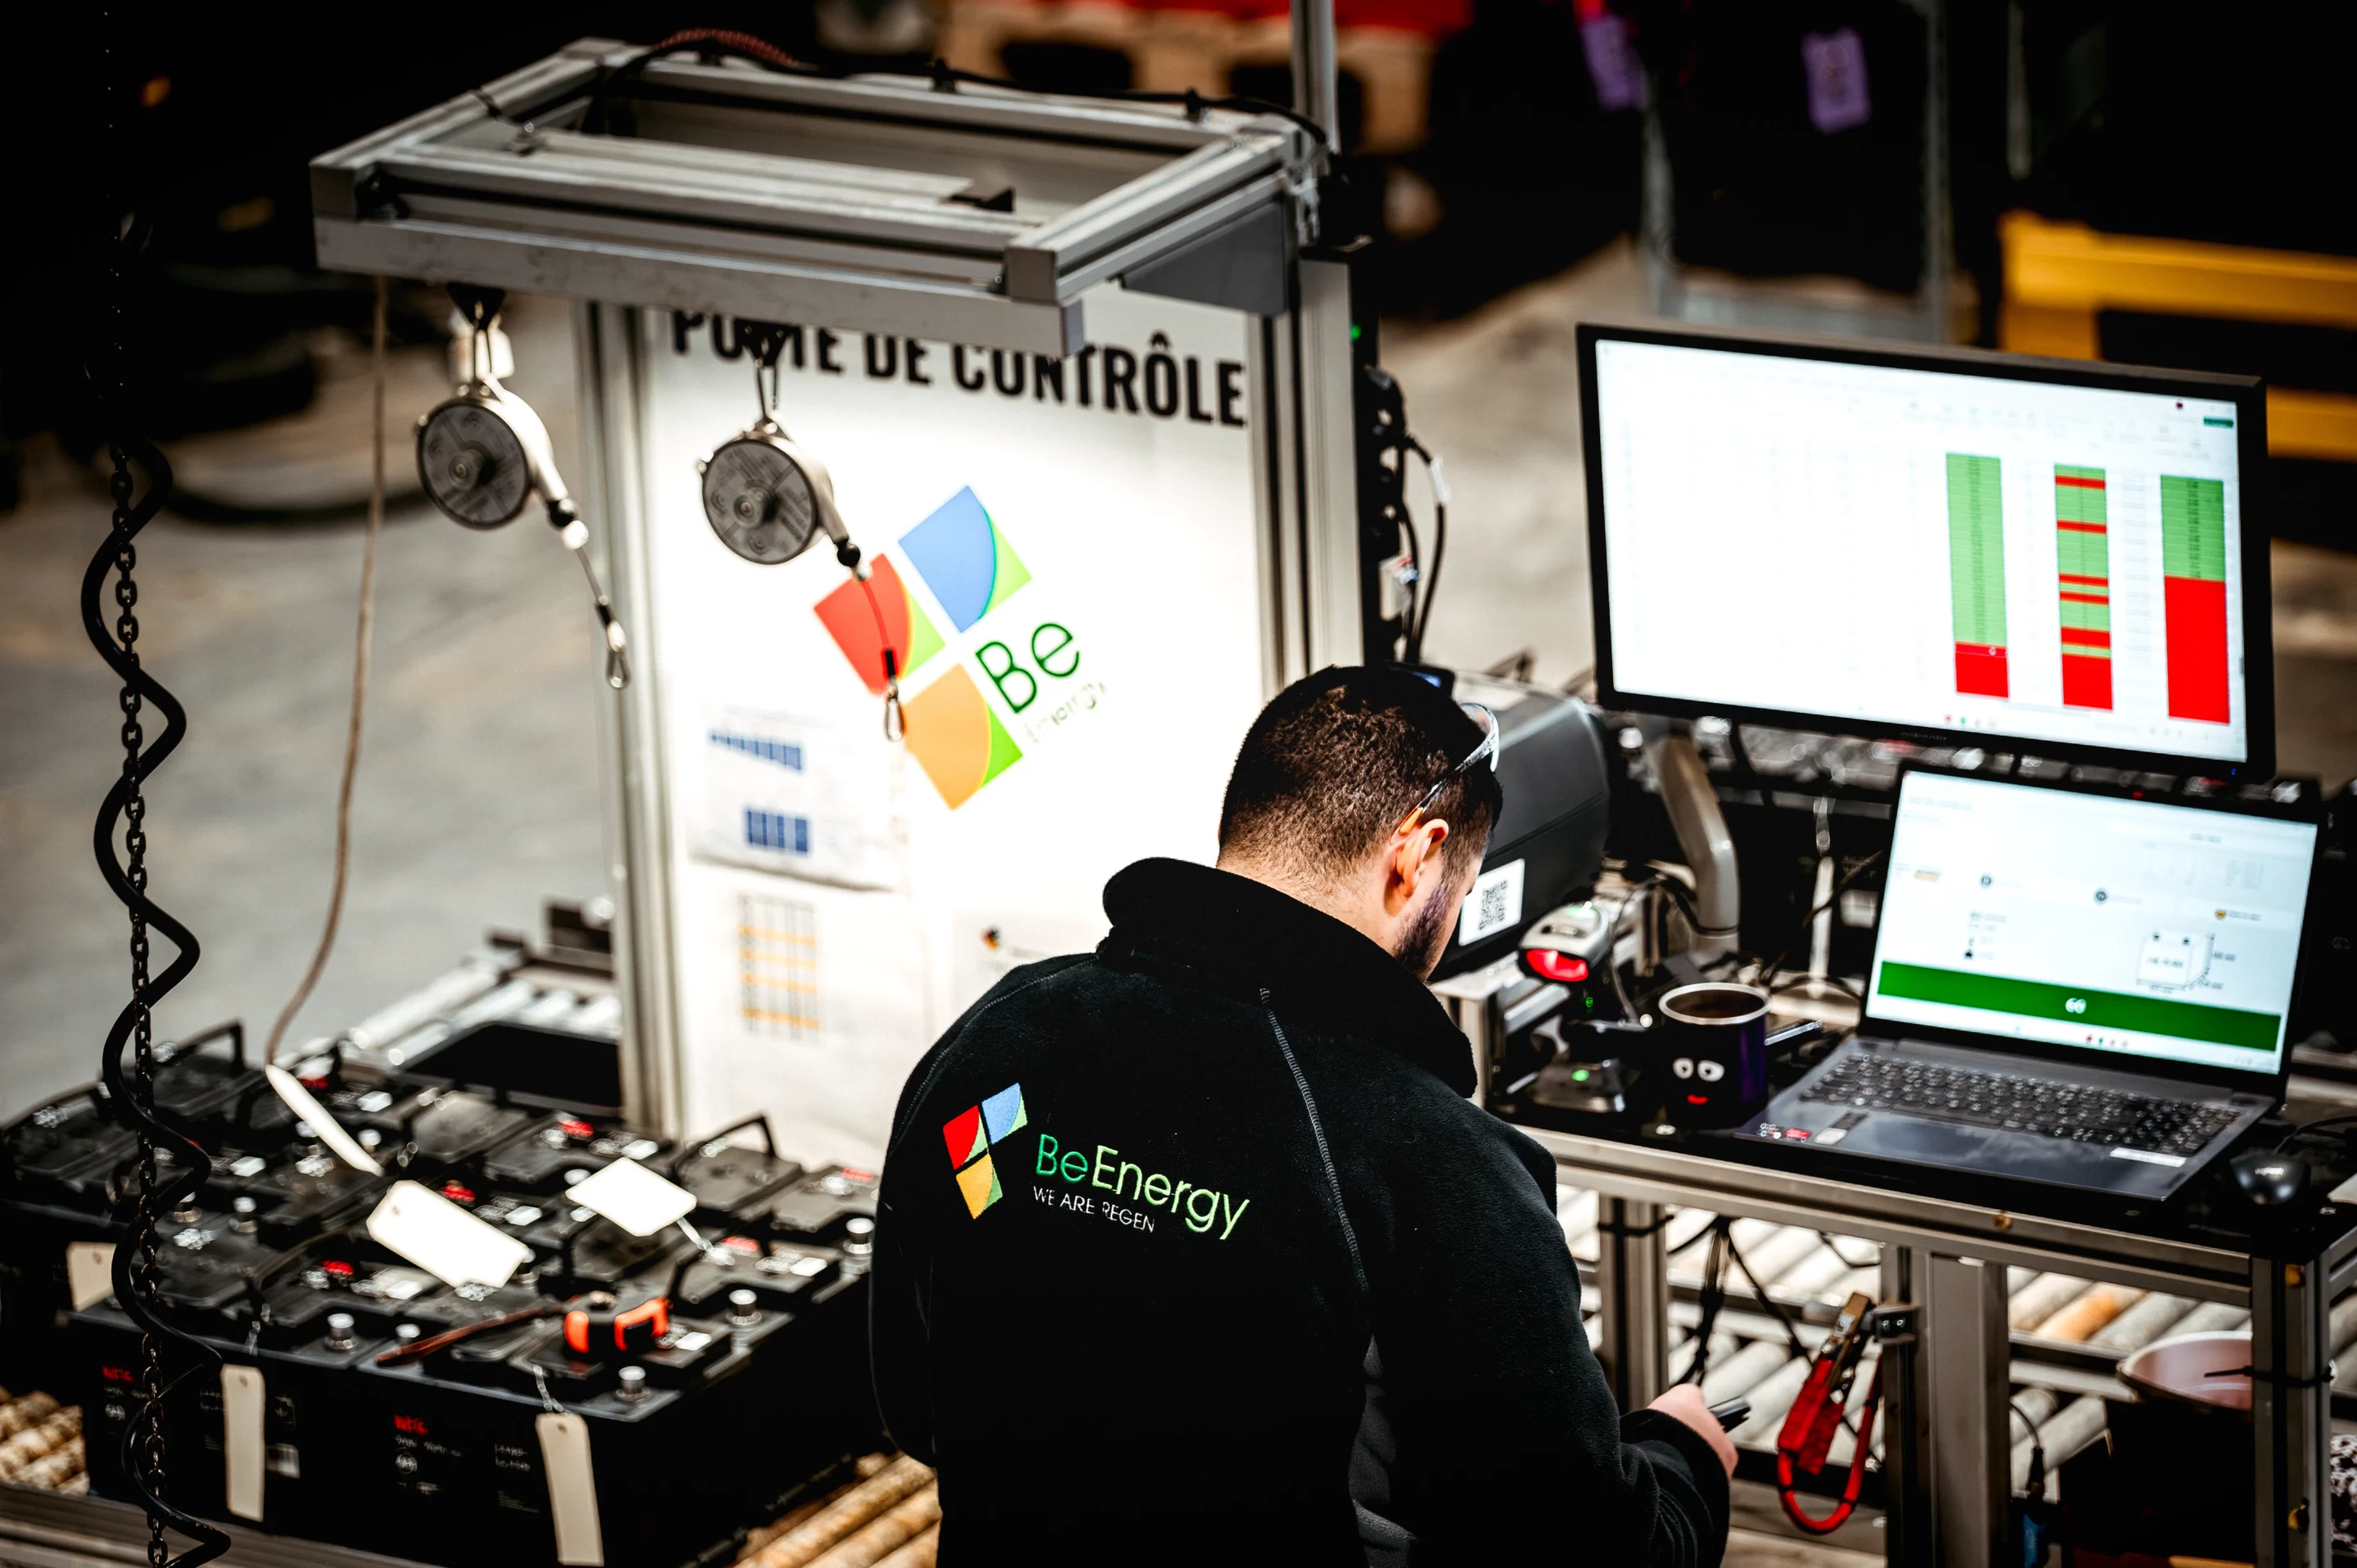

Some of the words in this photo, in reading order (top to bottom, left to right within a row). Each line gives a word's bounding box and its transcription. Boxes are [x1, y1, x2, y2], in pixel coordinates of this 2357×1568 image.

[863, 331, 932, 387] DE
[949, 330, 1246, 428] CONTRÔLE
[974, 622, 1080, 714] Be
[1033, 1185, 1056, 1205] WE
[1059, 1192, 1095, 1214] ARE
[1102, 1201, 1156, 1233] REGEN
[1035, 1133, 1250, 1240] BeEnergy
